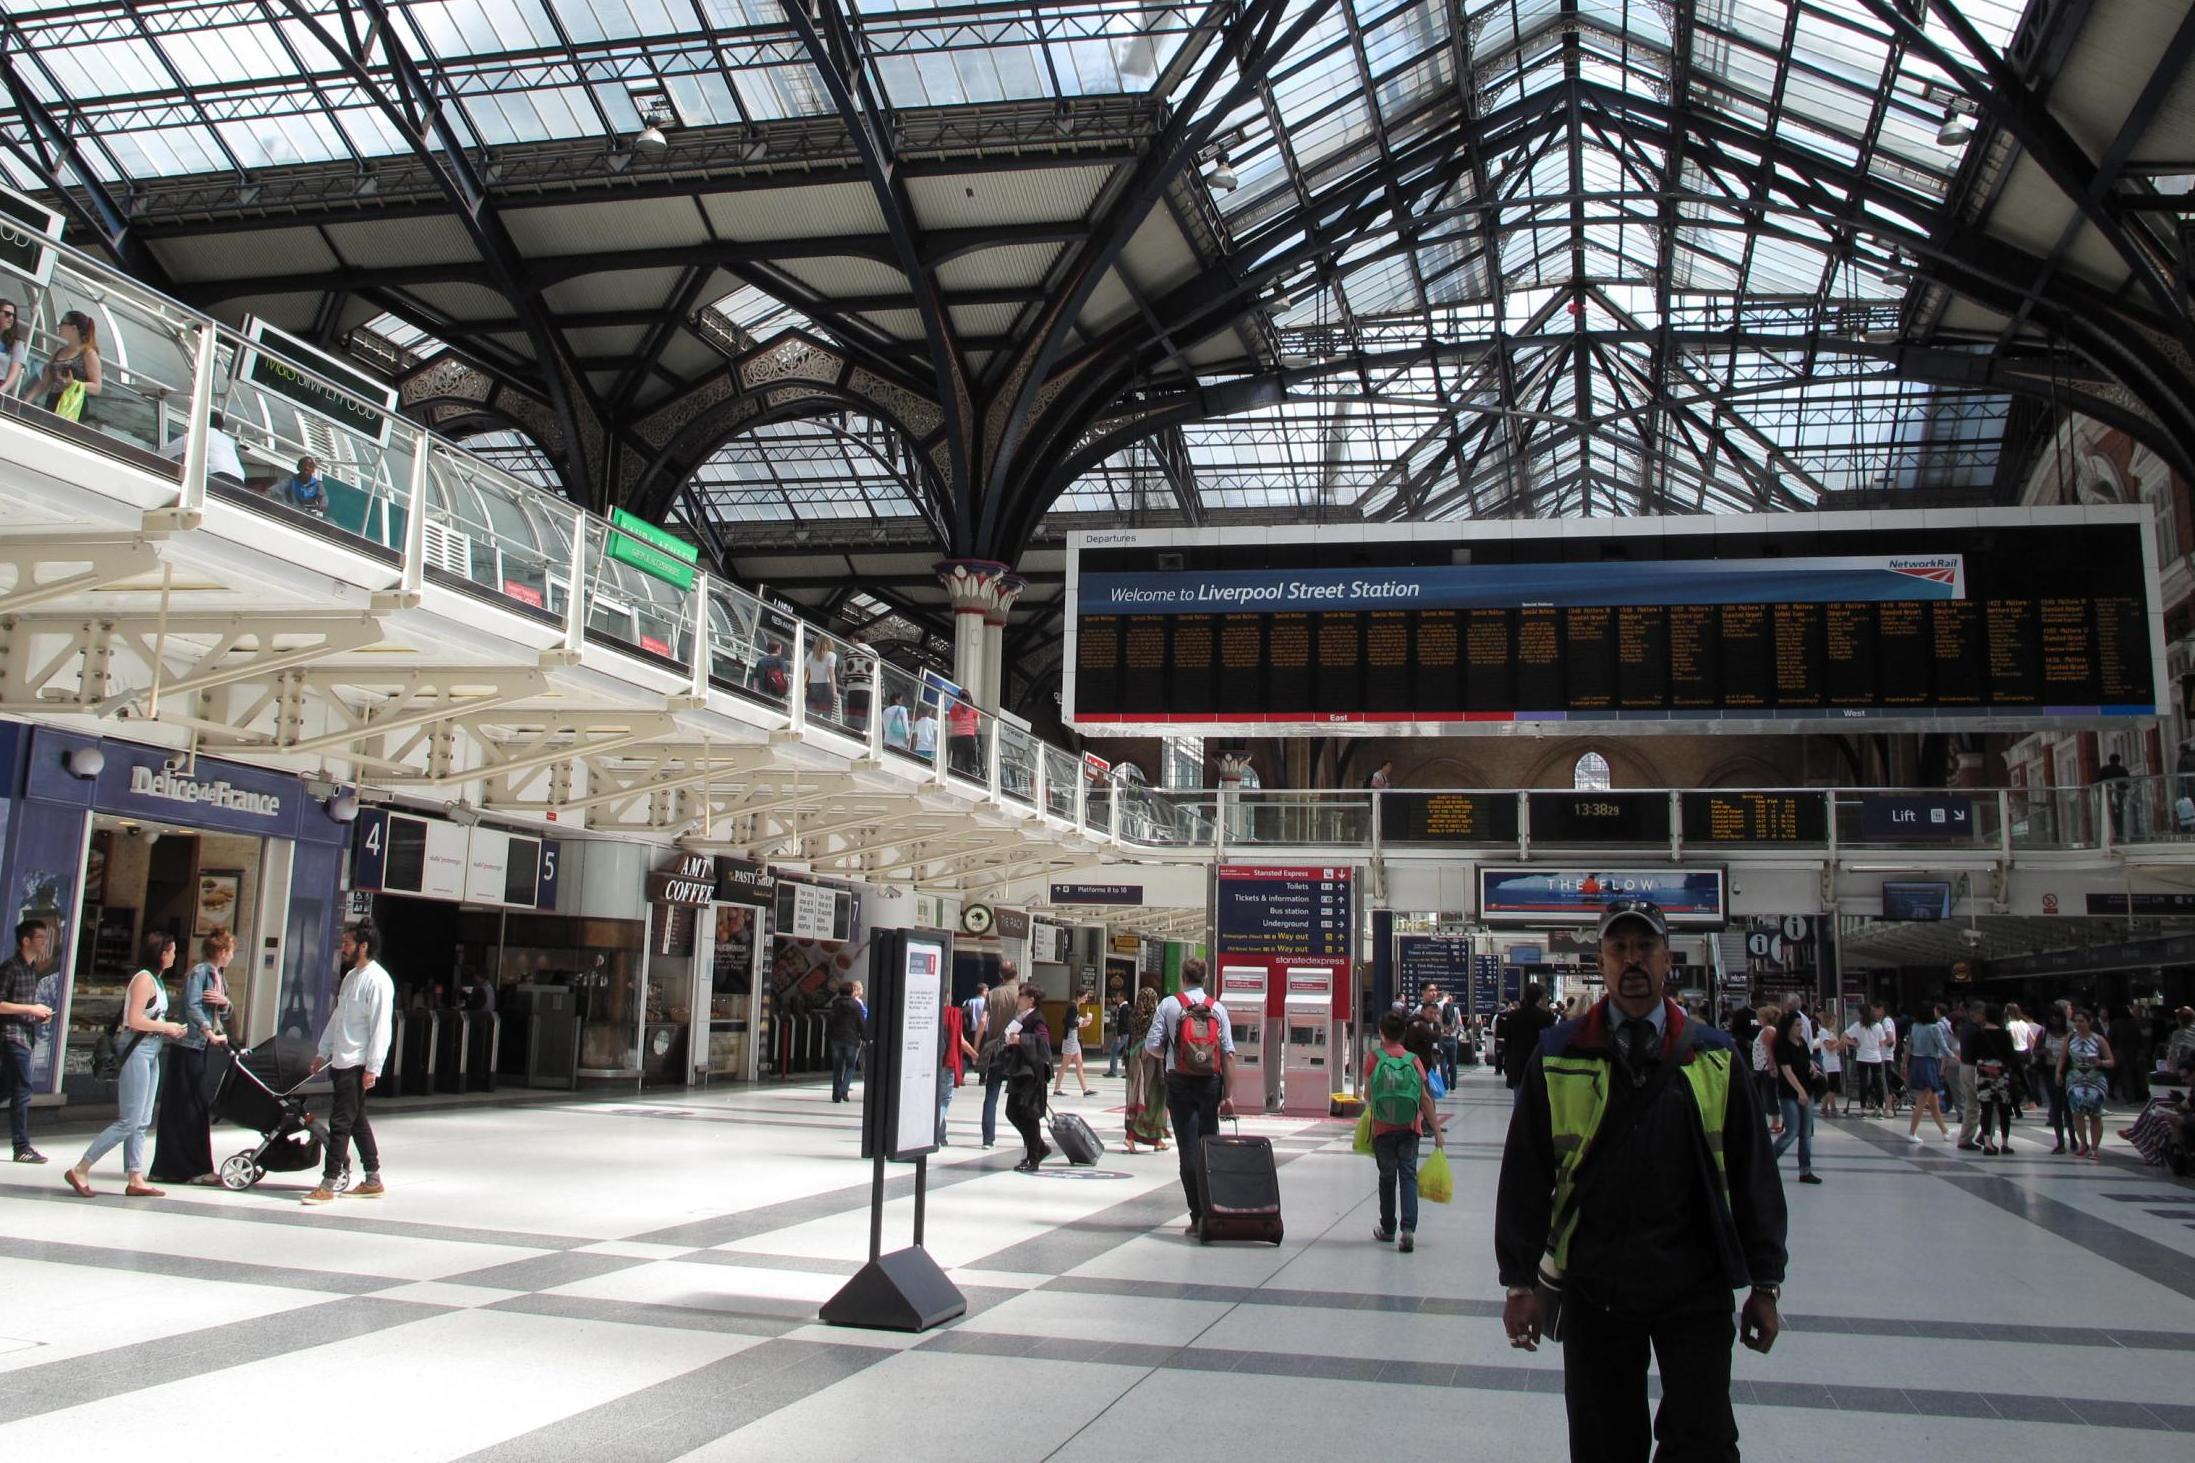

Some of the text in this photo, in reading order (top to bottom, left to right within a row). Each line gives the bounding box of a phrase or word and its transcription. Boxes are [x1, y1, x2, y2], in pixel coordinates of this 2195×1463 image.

[1086, 534, 1136, 544] Departures
[1111, 580, 1420, 604] Welcome to Liverpool Street Station
[1330, 713, 1347, 722] East
[1843, 709, 1866, 717] West
[197, 783, 214, 801] de
[212, 781, 280, 816] France
[1892, 809, 1916, 822] Lift
[365, 822, 380, 856] 4
[543, 851, 554, 881] 5
[680, 856, 710, 879] AMT
[735, 870, 755, 884] PASTY
[756, 873, 775, 888] SHOP
[1254, 869, 1282, 878] Stansted
[1284, 869, 1309, 879] Express
[1287, 882, 1309, 891] Toilets
[1546, 879, 1654, 890] THE FLOW
[665, 879, 714, 905] COFFEE
[1077, 886, 1105, 894] Platforms
[1234, 893, 1309, 903] Tickets & information
[852, 900, 860, 922] 7
[1269, 907, 1309, 916] Bus station
[1262, 920, 1309, 929] Underground
[1064, 934, 1070, 951] 9
[1277, 933, 1292, 943] Way
[1277, 945, 1292, 955] Way
